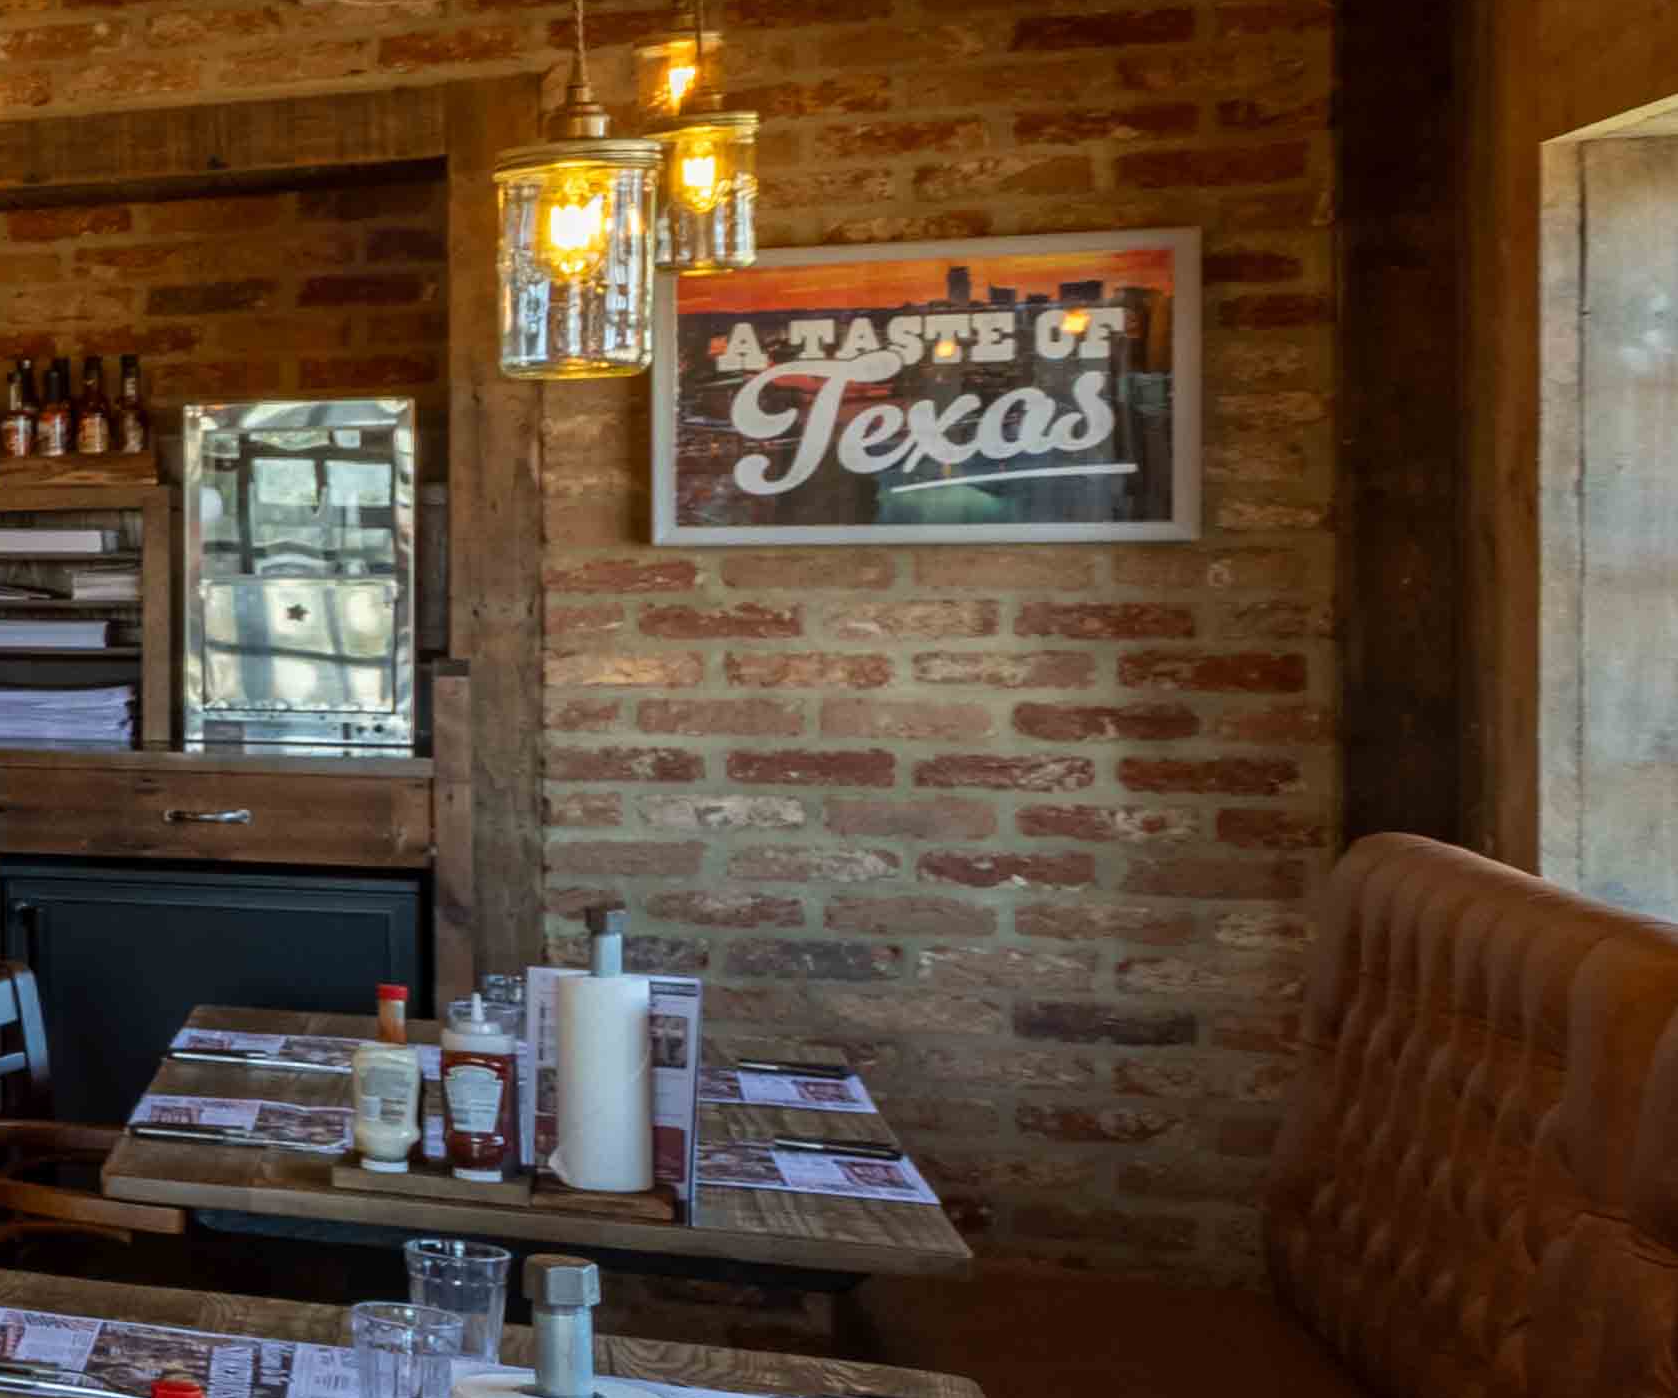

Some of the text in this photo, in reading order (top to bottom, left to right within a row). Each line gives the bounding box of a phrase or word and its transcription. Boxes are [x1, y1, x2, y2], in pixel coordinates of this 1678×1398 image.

[717, 306, 1126, 372] A TASTE OF
[732, 344, 1118, 495] Texas
